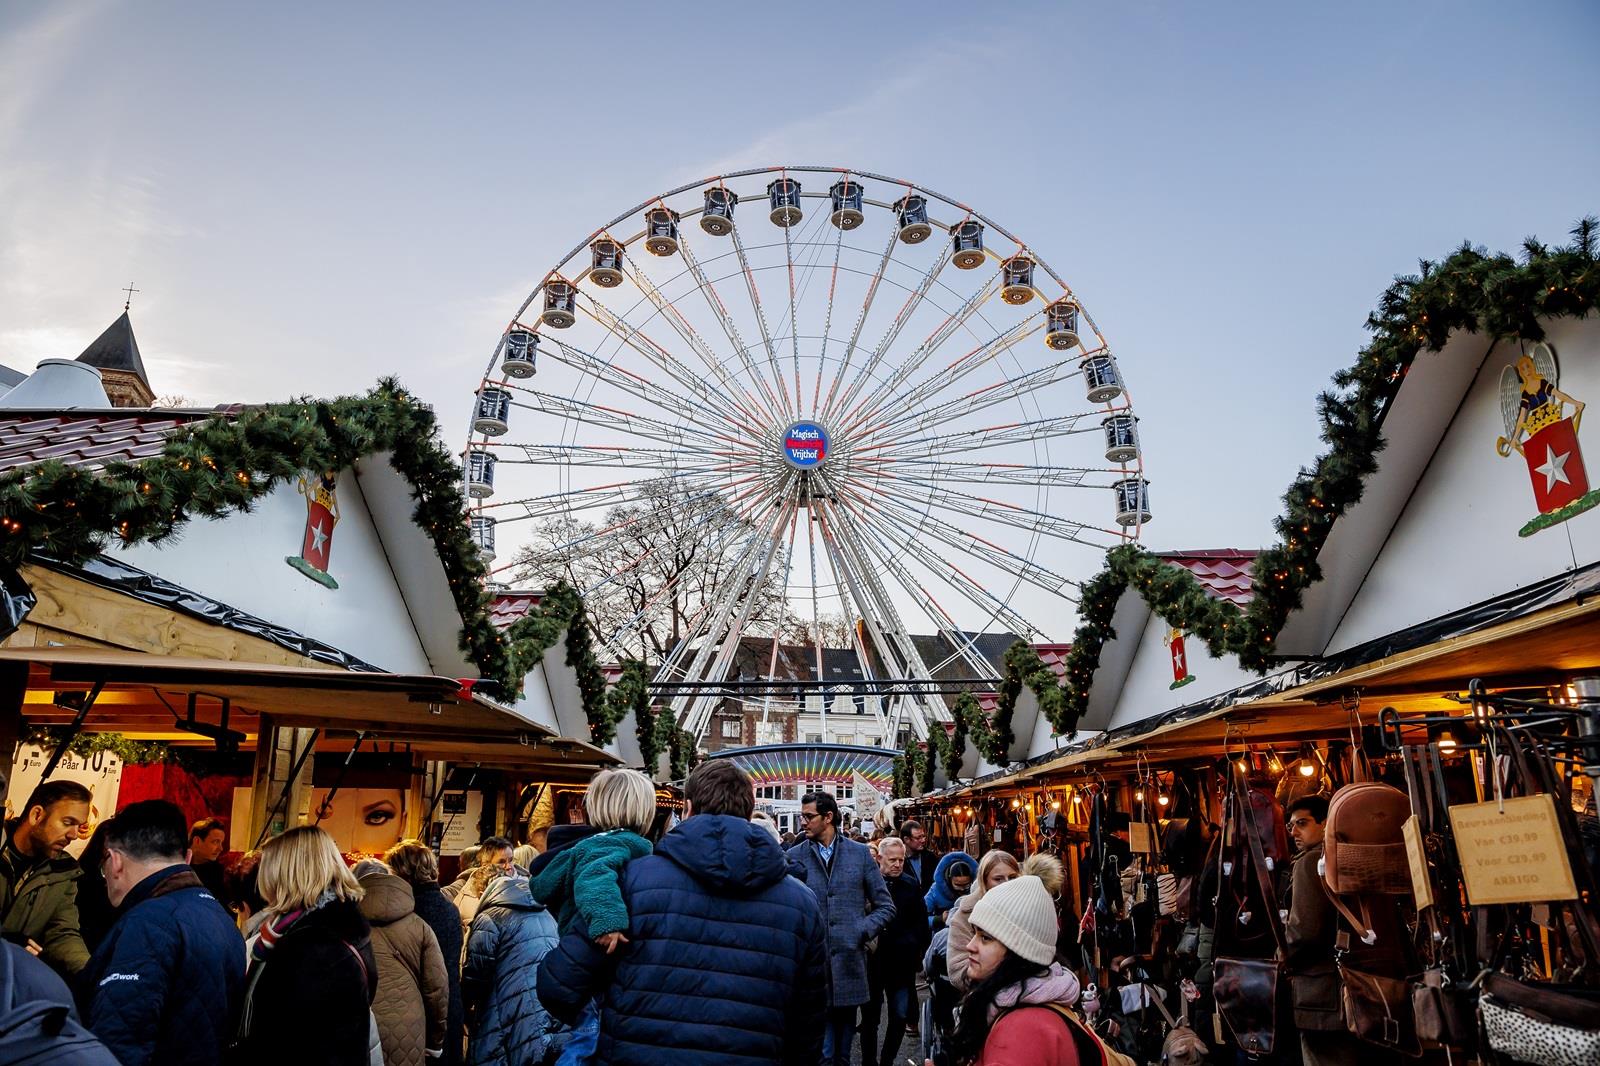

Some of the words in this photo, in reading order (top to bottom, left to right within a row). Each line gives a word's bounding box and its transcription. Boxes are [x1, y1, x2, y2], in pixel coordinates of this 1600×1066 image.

[791, 429, 819, 440] Magisch
[792, 449, 818, 460] Vrijthof
[29, 759, 42, 768] Euro
[61, 758, 80, 771] Paar
[107, 767, 117, 775] Euro
[1474, 838, 1496, 847] Van
[1476, 858, 1502, 867] Voor
[1493, 873, 1540, 886] ARRIGO
